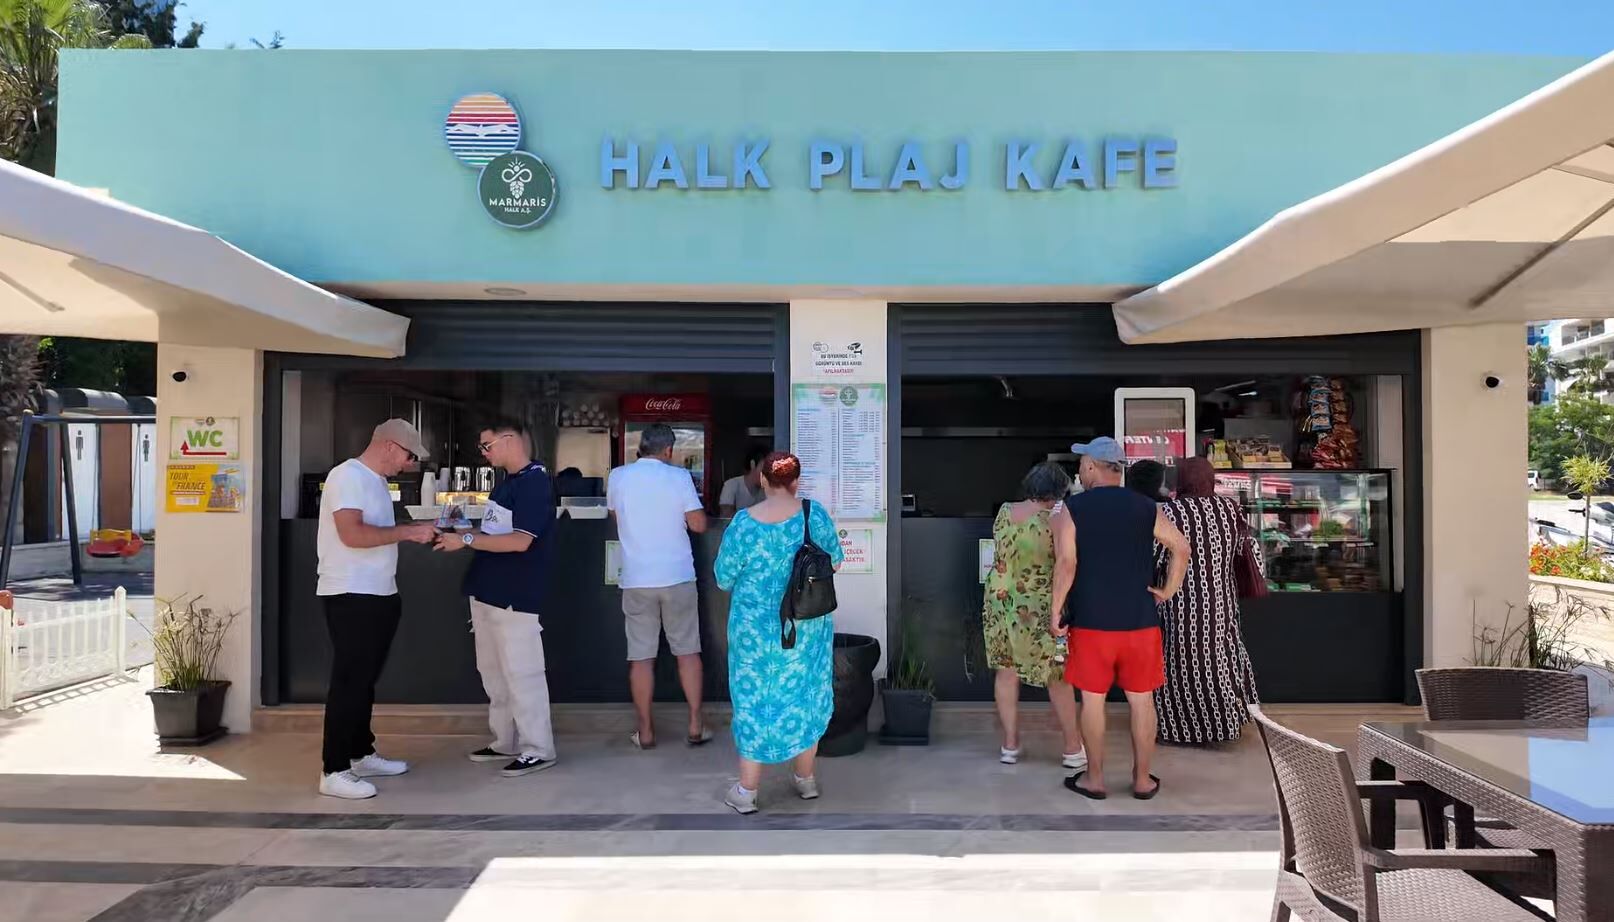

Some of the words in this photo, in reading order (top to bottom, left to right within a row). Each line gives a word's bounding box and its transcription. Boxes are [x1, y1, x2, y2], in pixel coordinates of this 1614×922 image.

[601, 138, 772, 190] HALK
[809, 138, 970, 190] PLAJ
[1005, 138, 1178, 190] KAFE
[489, 197, 547, 207] MARMARİS
[645, 398, 682, 410] Coca-Cola
[187, 430, 223, 447] WC
